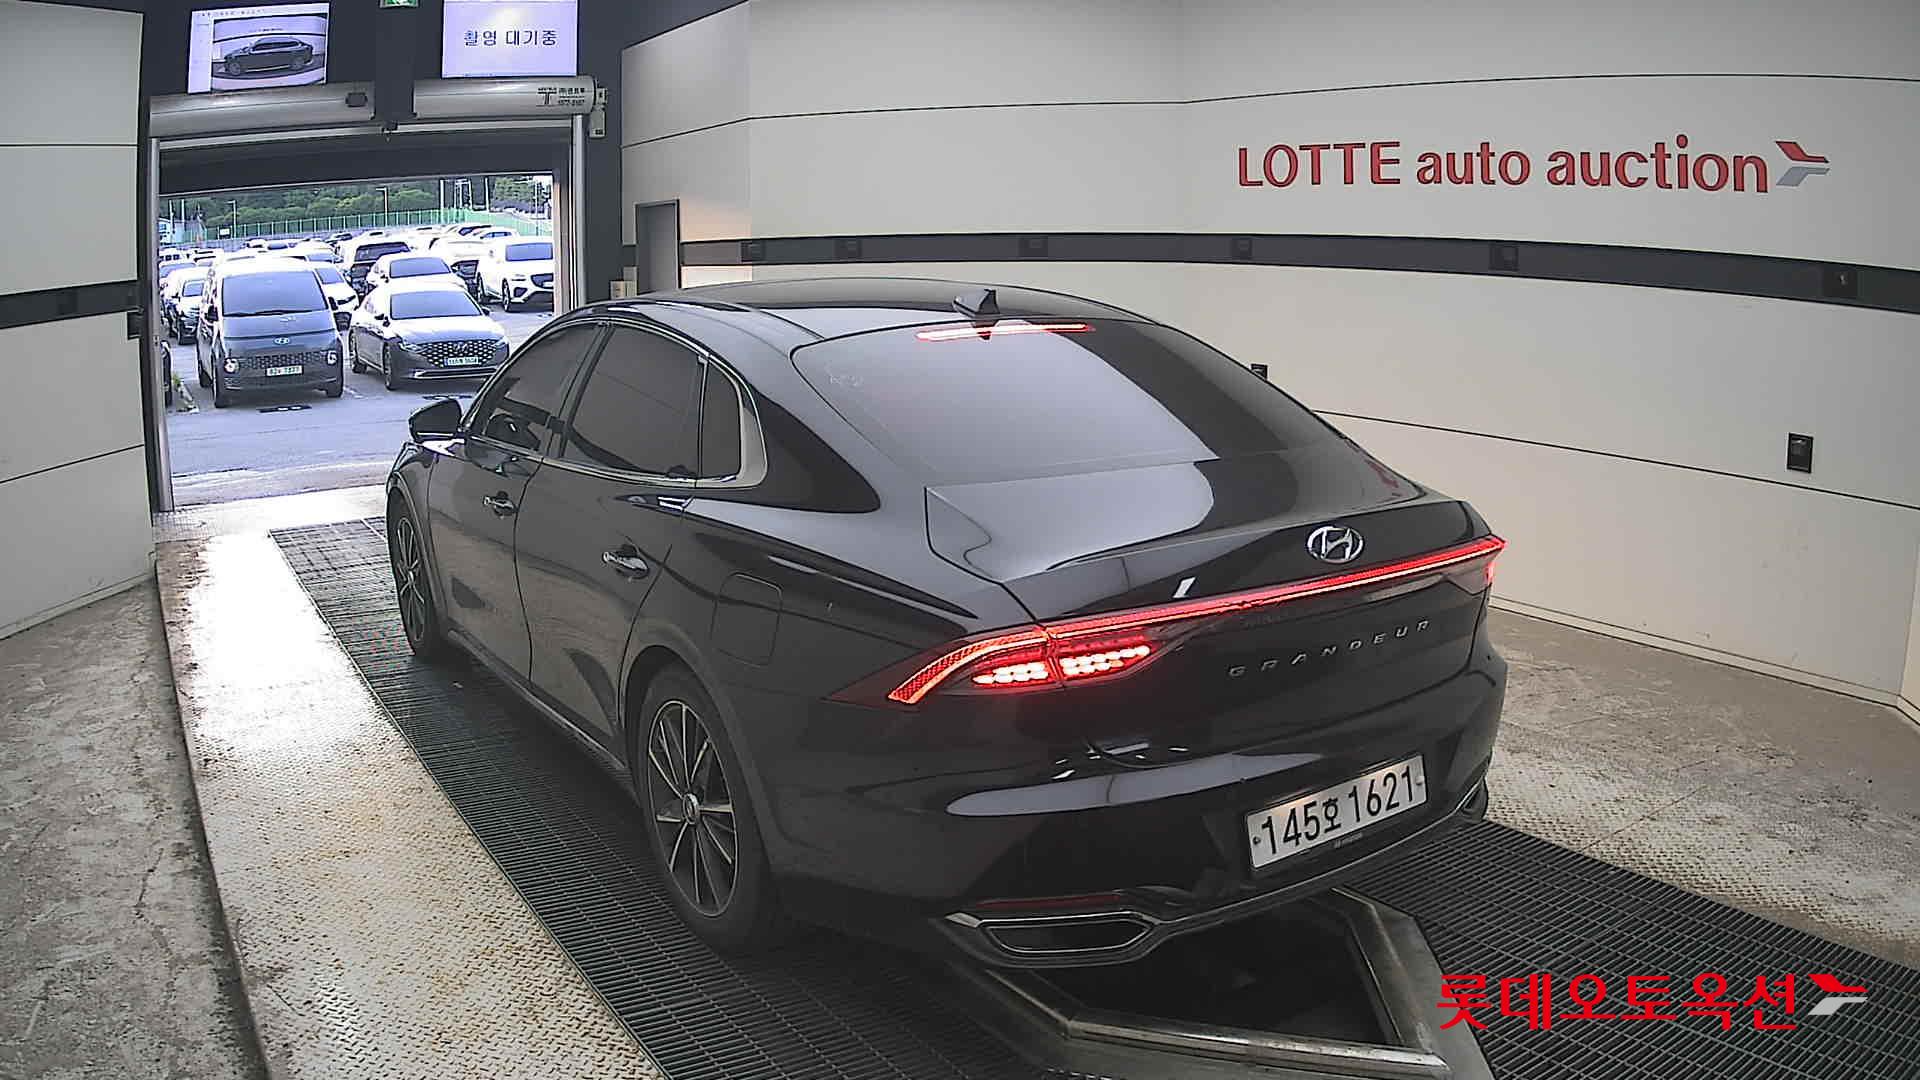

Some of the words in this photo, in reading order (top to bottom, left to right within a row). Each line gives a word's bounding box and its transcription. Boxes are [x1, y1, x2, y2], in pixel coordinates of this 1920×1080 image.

[463, 29, 497, 47] 촬영
[504, 29, 557, 46] 대기중
[1239, 142, 1401, 188] LOTTE
[1415, 142, 1531, 186] auto
[1546, 134, 1769, 193] auction
[1228, 619, 1429, 677] GRANDEUR
[1261, 798, 1342, 855] 145호
[1348, 765, 1413, 823] 1621
